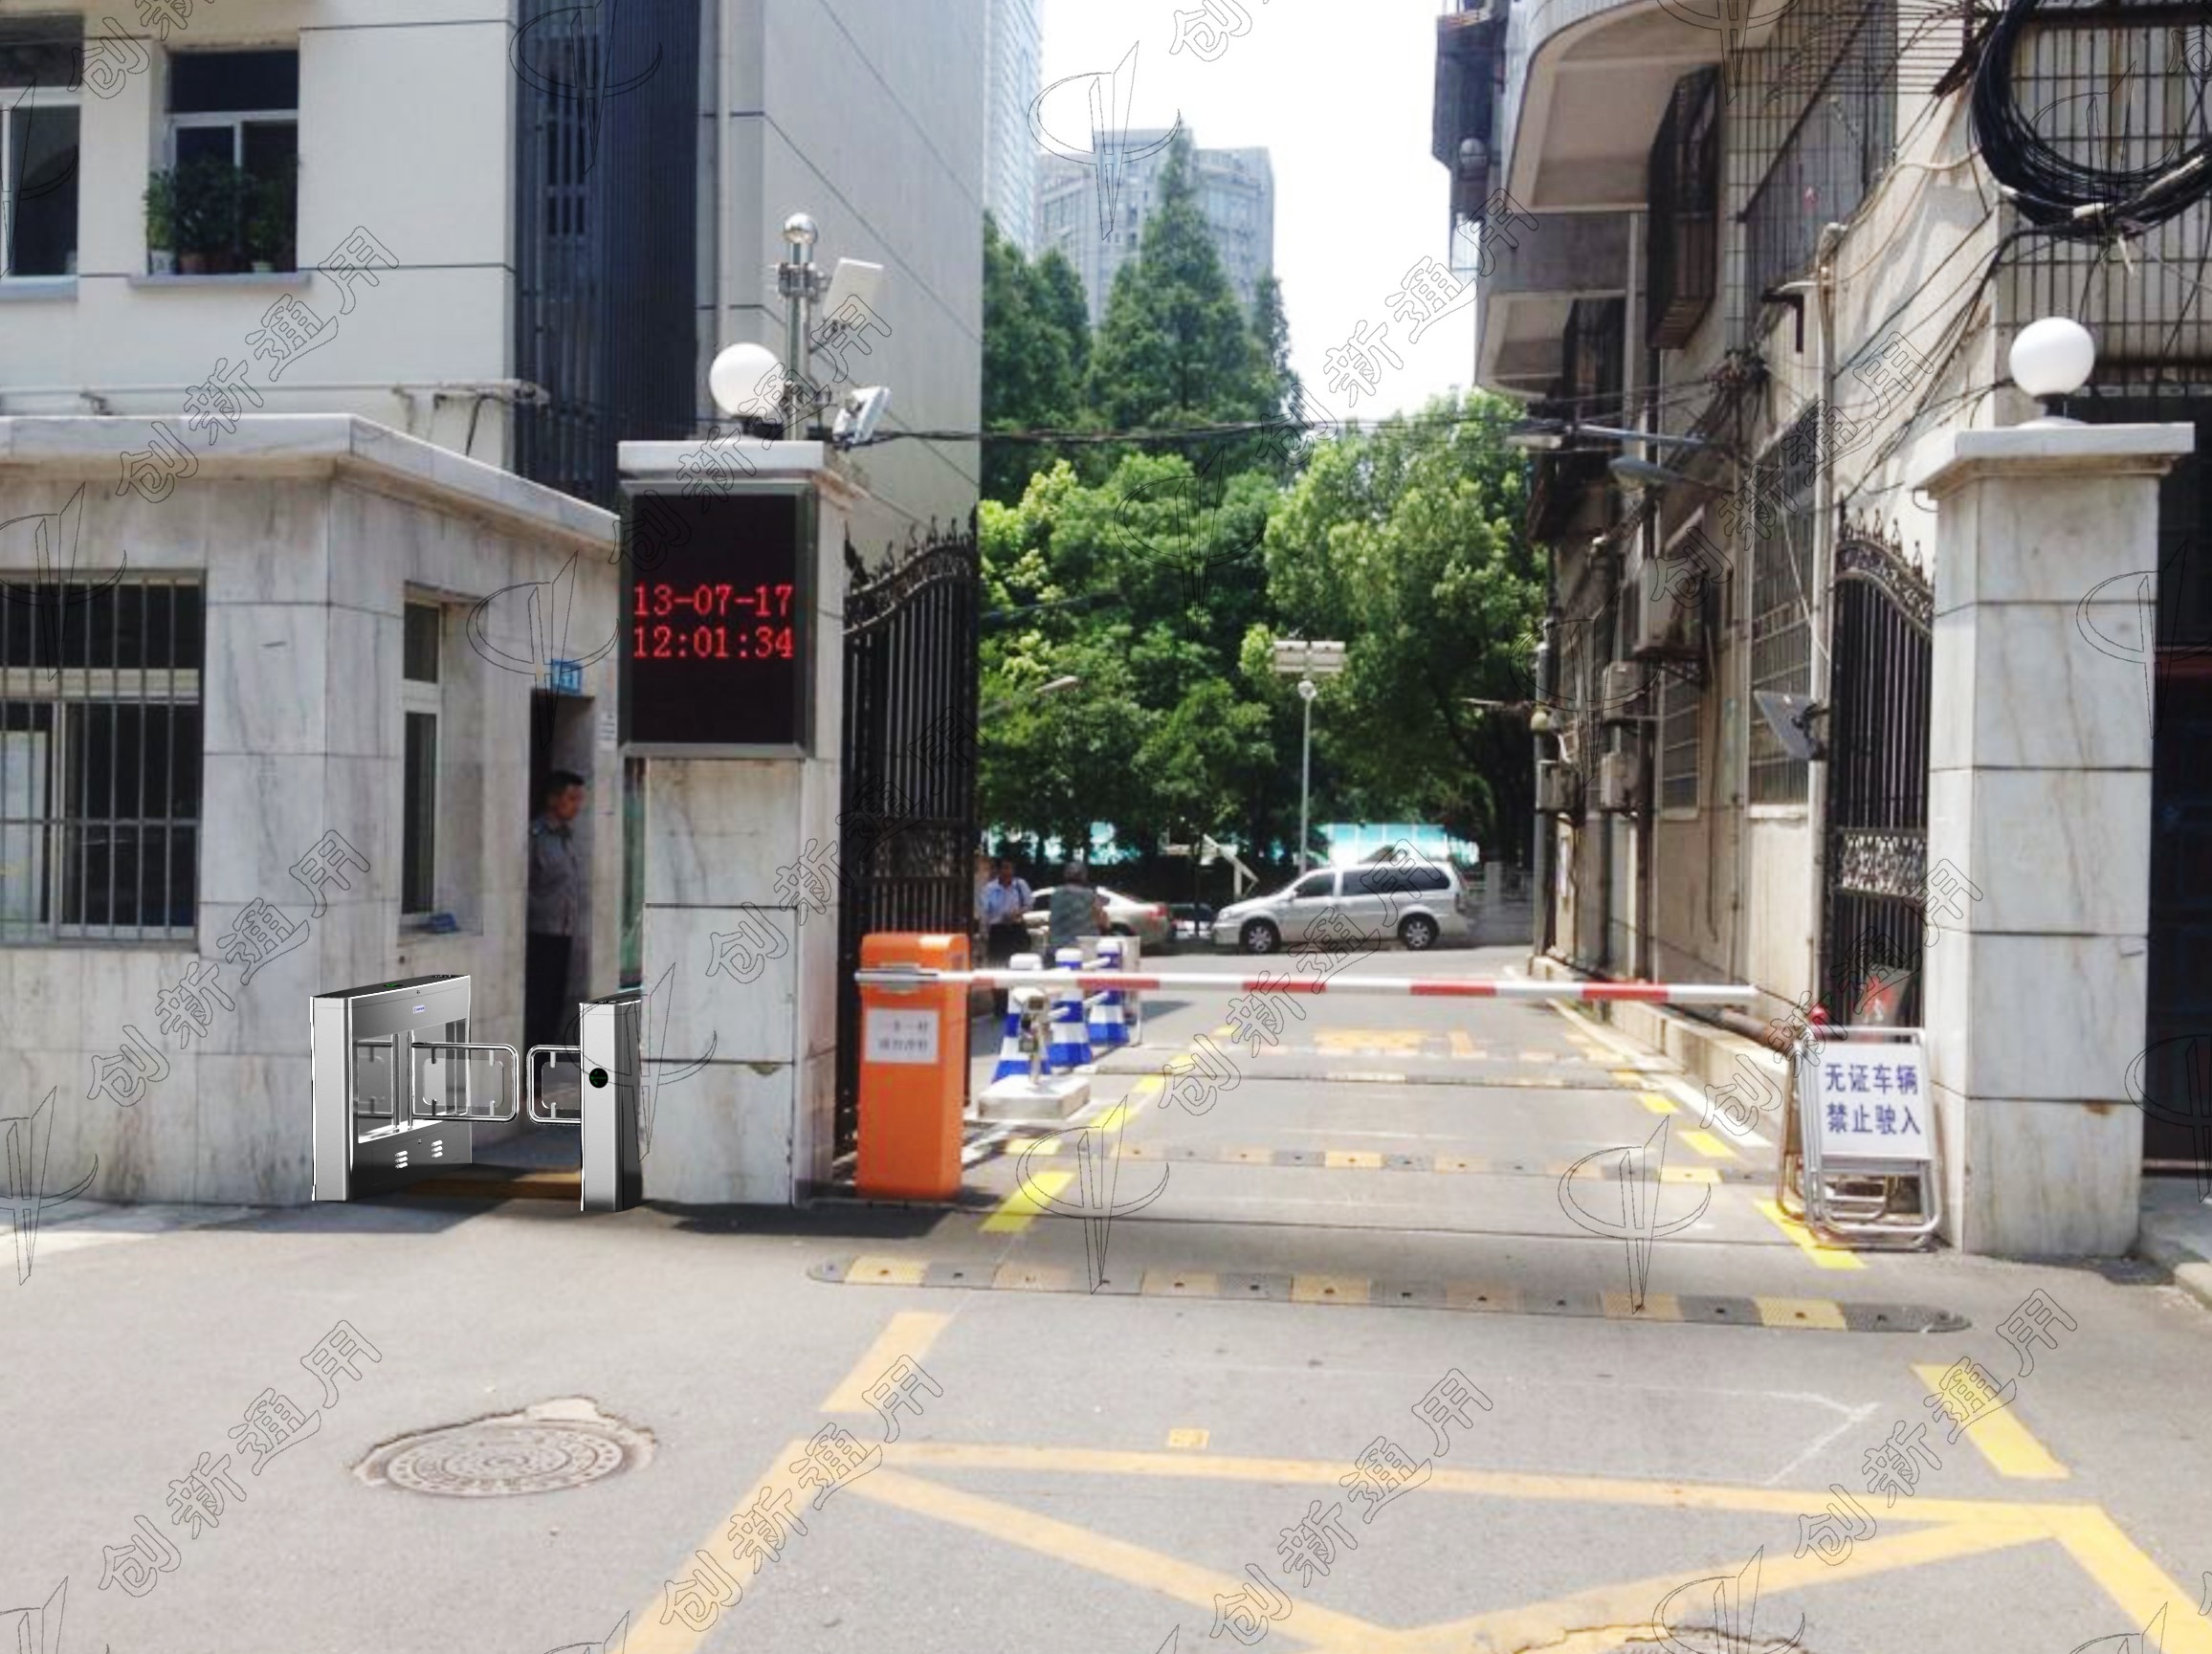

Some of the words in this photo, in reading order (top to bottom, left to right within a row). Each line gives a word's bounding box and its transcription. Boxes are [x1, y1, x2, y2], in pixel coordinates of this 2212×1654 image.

[633, 584, 793, 616] 13-07-17
[633, 627, 793, 658] 12:01:34
[1825, 1063, 1918, 1094] 无证车辆
[1826, 1102, 1921, 1135] 禁止驶入
